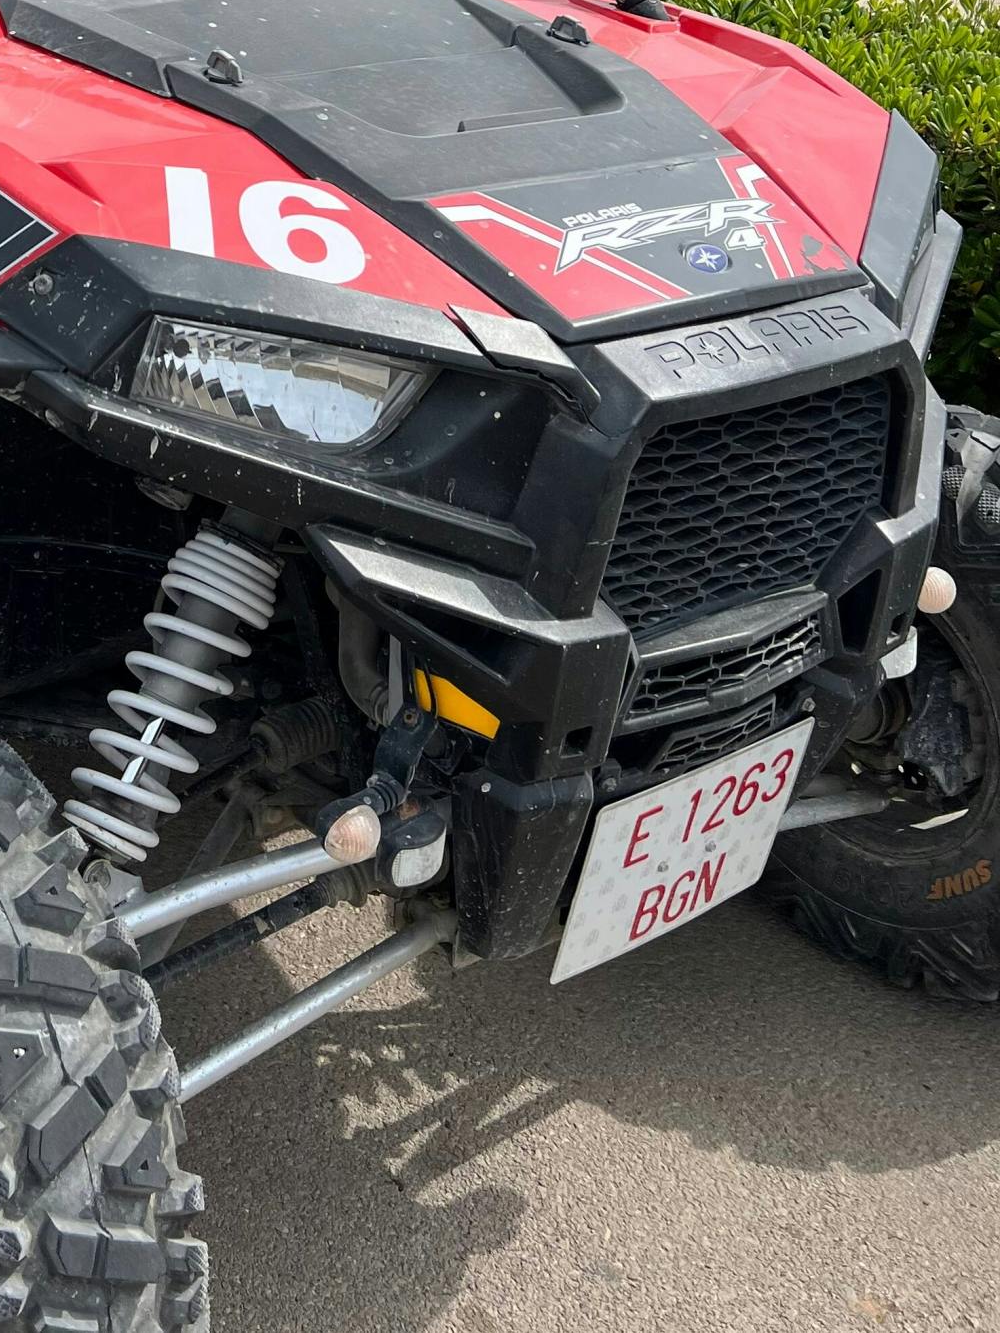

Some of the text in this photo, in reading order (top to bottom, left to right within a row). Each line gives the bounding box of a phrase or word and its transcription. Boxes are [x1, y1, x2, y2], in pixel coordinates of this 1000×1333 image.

[164, 165, 366, 284] 16
[554, 198, 786, 275] RZR
[561, 202, 642, 228] POLARIS
[724, 225, 767, 250] 4
[643, 304, 871, 380] POLARIS
[623, 748, 794, 869] E 1263
[628, 852, 727, 942] BGN
